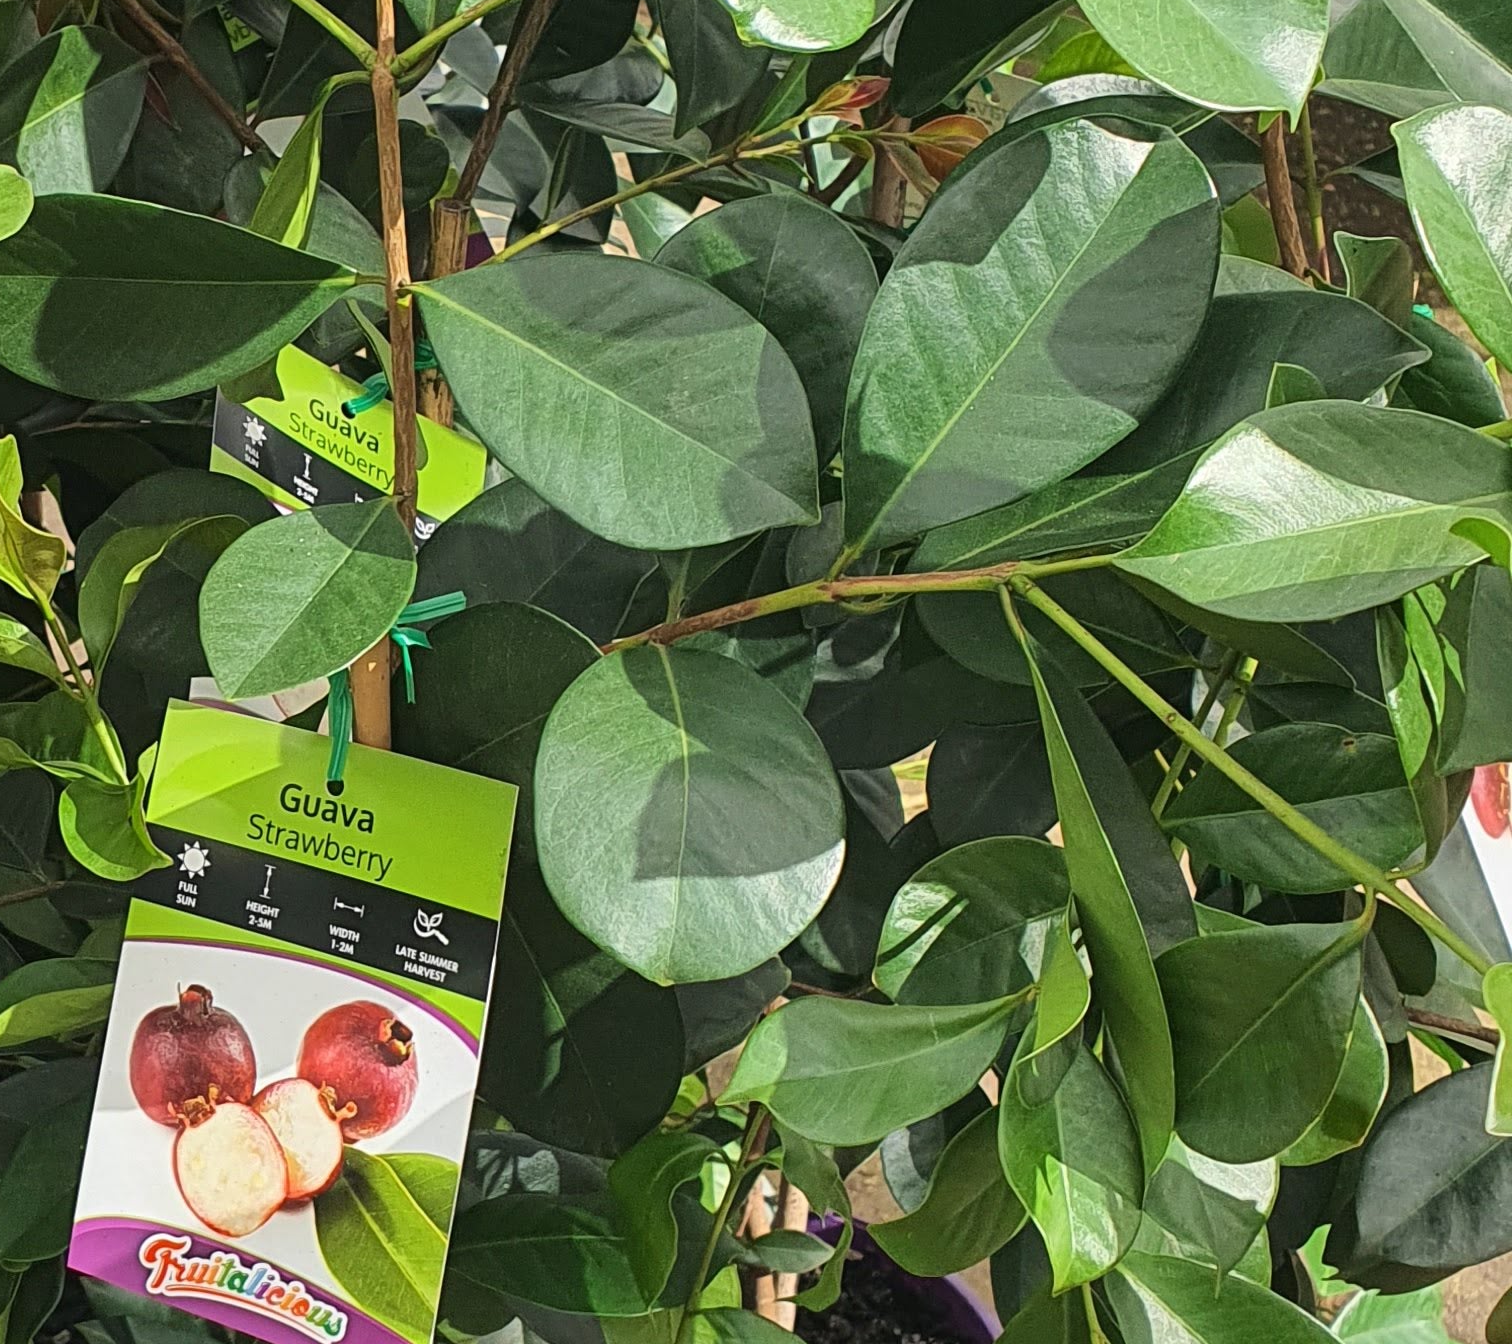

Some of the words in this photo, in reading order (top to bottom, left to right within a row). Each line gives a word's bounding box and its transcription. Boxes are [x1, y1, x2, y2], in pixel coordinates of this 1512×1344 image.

[308, 398, 380, 455] Guava
[288, 412, 396, 490] Strawberry
[279, 783, 375, 834] Guava
[246, 813, 394, 882] Strawberry
[177, 880, 198, 895] FULL
[175, 893, 197, 908] SUN
[245, 900, 281, 918] HEIGHT
[248, 914, 273, 931] 2-5M
[329, 923, 360, 943] WIDTH
[331, 939, 354, 955] 1-2M
[395, 944, 417, 960] LATE
[418, 951, 459, 974] SUMMER
[403, 960, 447, 983] HARVEST
[141, 1236, 345, 1339] Fruitalicious
